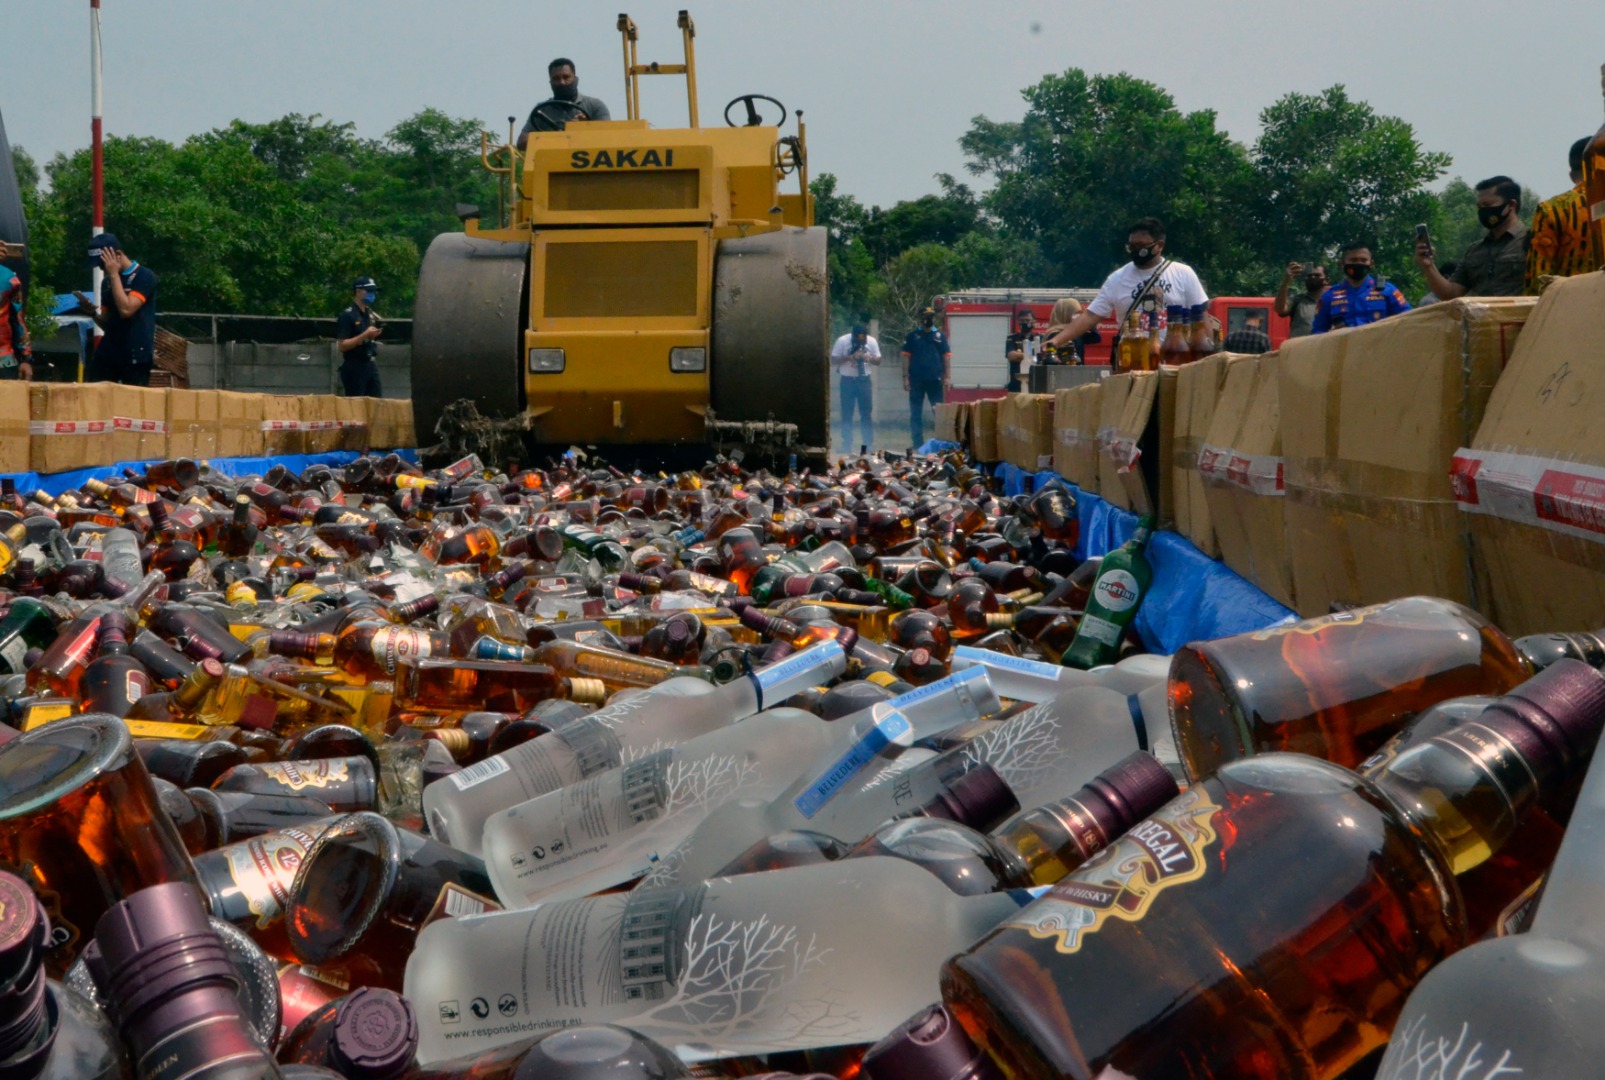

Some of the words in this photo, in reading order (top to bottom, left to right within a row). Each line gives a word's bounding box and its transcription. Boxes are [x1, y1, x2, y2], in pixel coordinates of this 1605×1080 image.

[570, 149, 674, 169] SAKAI
[1099, 582, 1136, 601] MARTINI
[816, 754, 860, 796] BELVEDERE
[279, 827, 314, 850] CHIVA
[1130, 820, 1188, 873] REGAL
[1065, 888, 1113, 904] WHISKY
[443, 1017, 582, 1040] www.responsibledrinking.eu
